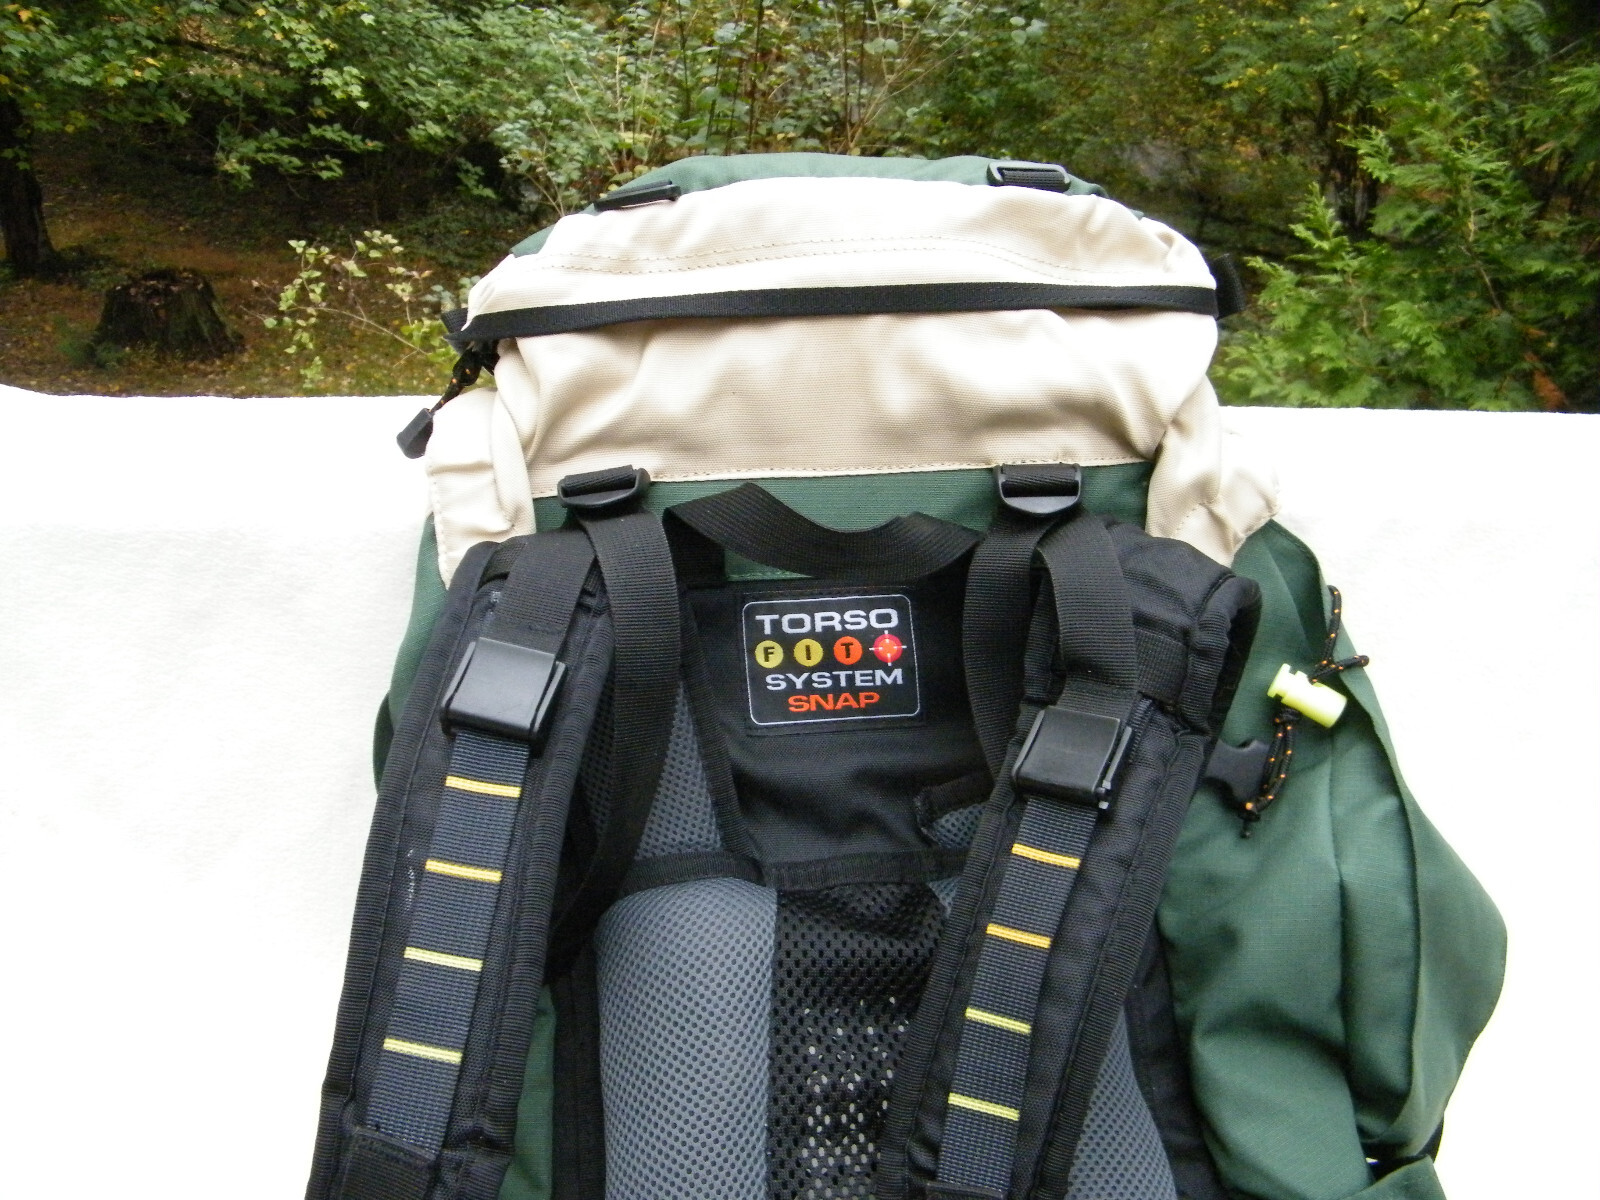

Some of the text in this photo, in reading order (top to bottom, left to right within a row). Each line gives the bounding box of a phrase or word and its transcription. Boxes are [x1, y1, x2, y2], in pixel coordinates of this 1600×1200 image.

[755, 608, 898, 635] TORSO
[760, 641, 856, 665] FIT
[765, 668, 903, 690] SYSTEM
[788, 692, 880, 712] SNAP
